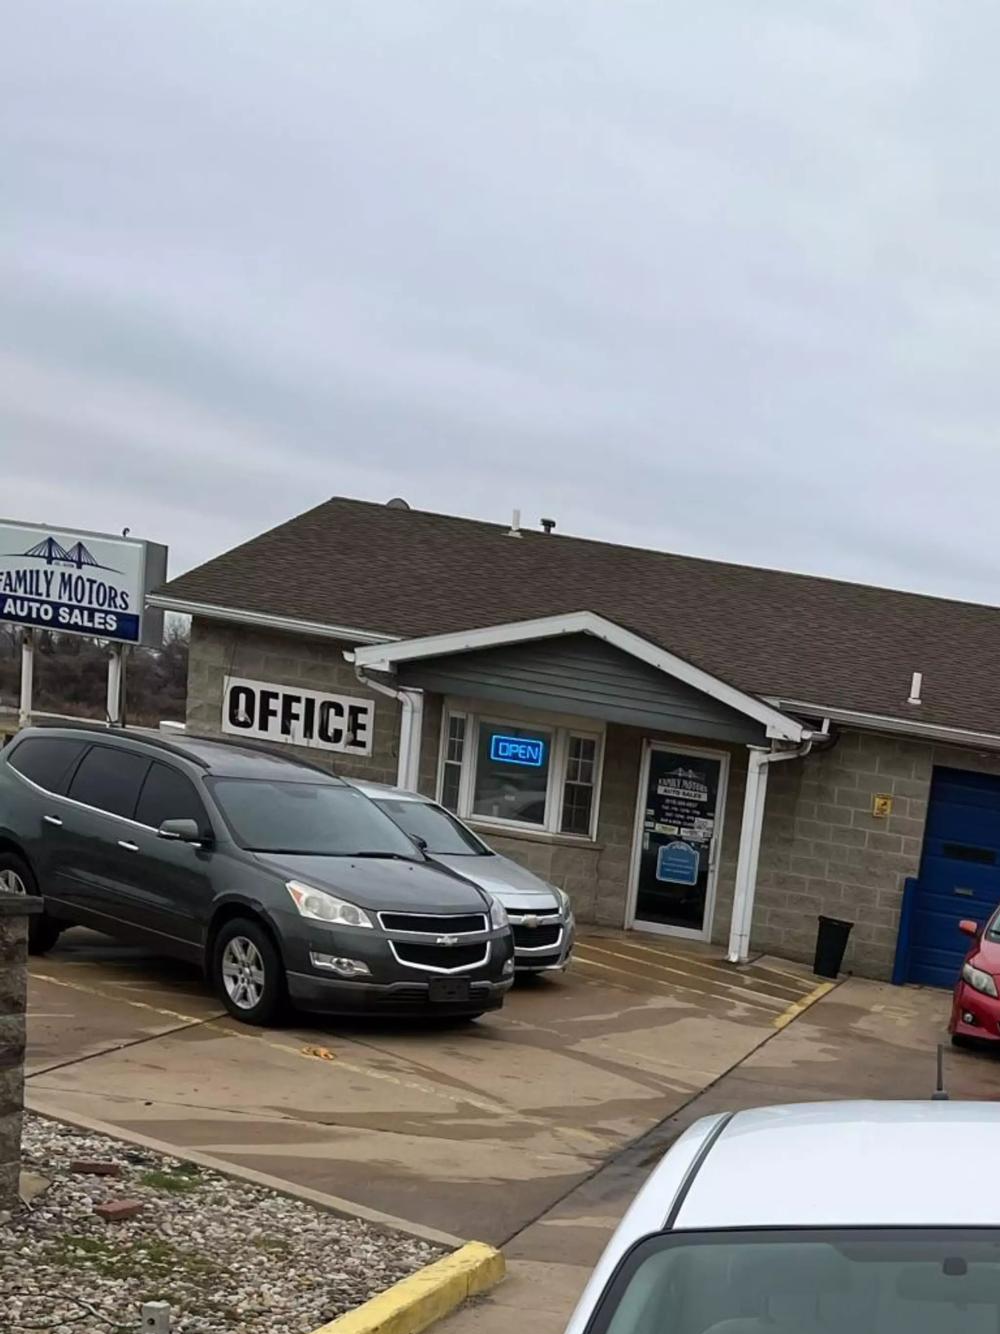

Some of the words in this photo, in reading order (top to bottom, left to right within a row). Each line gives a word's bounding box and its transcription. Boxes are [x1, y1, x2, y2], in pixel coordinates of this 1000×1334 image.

[58, 571, 130, 611] MOTORS
[3, 598, 54, 621] AUTO
[58, 606, 118, 631] SALES
[228, 685, 369, 748] OFFICE
[498, 742, 539, 760] OPEN
